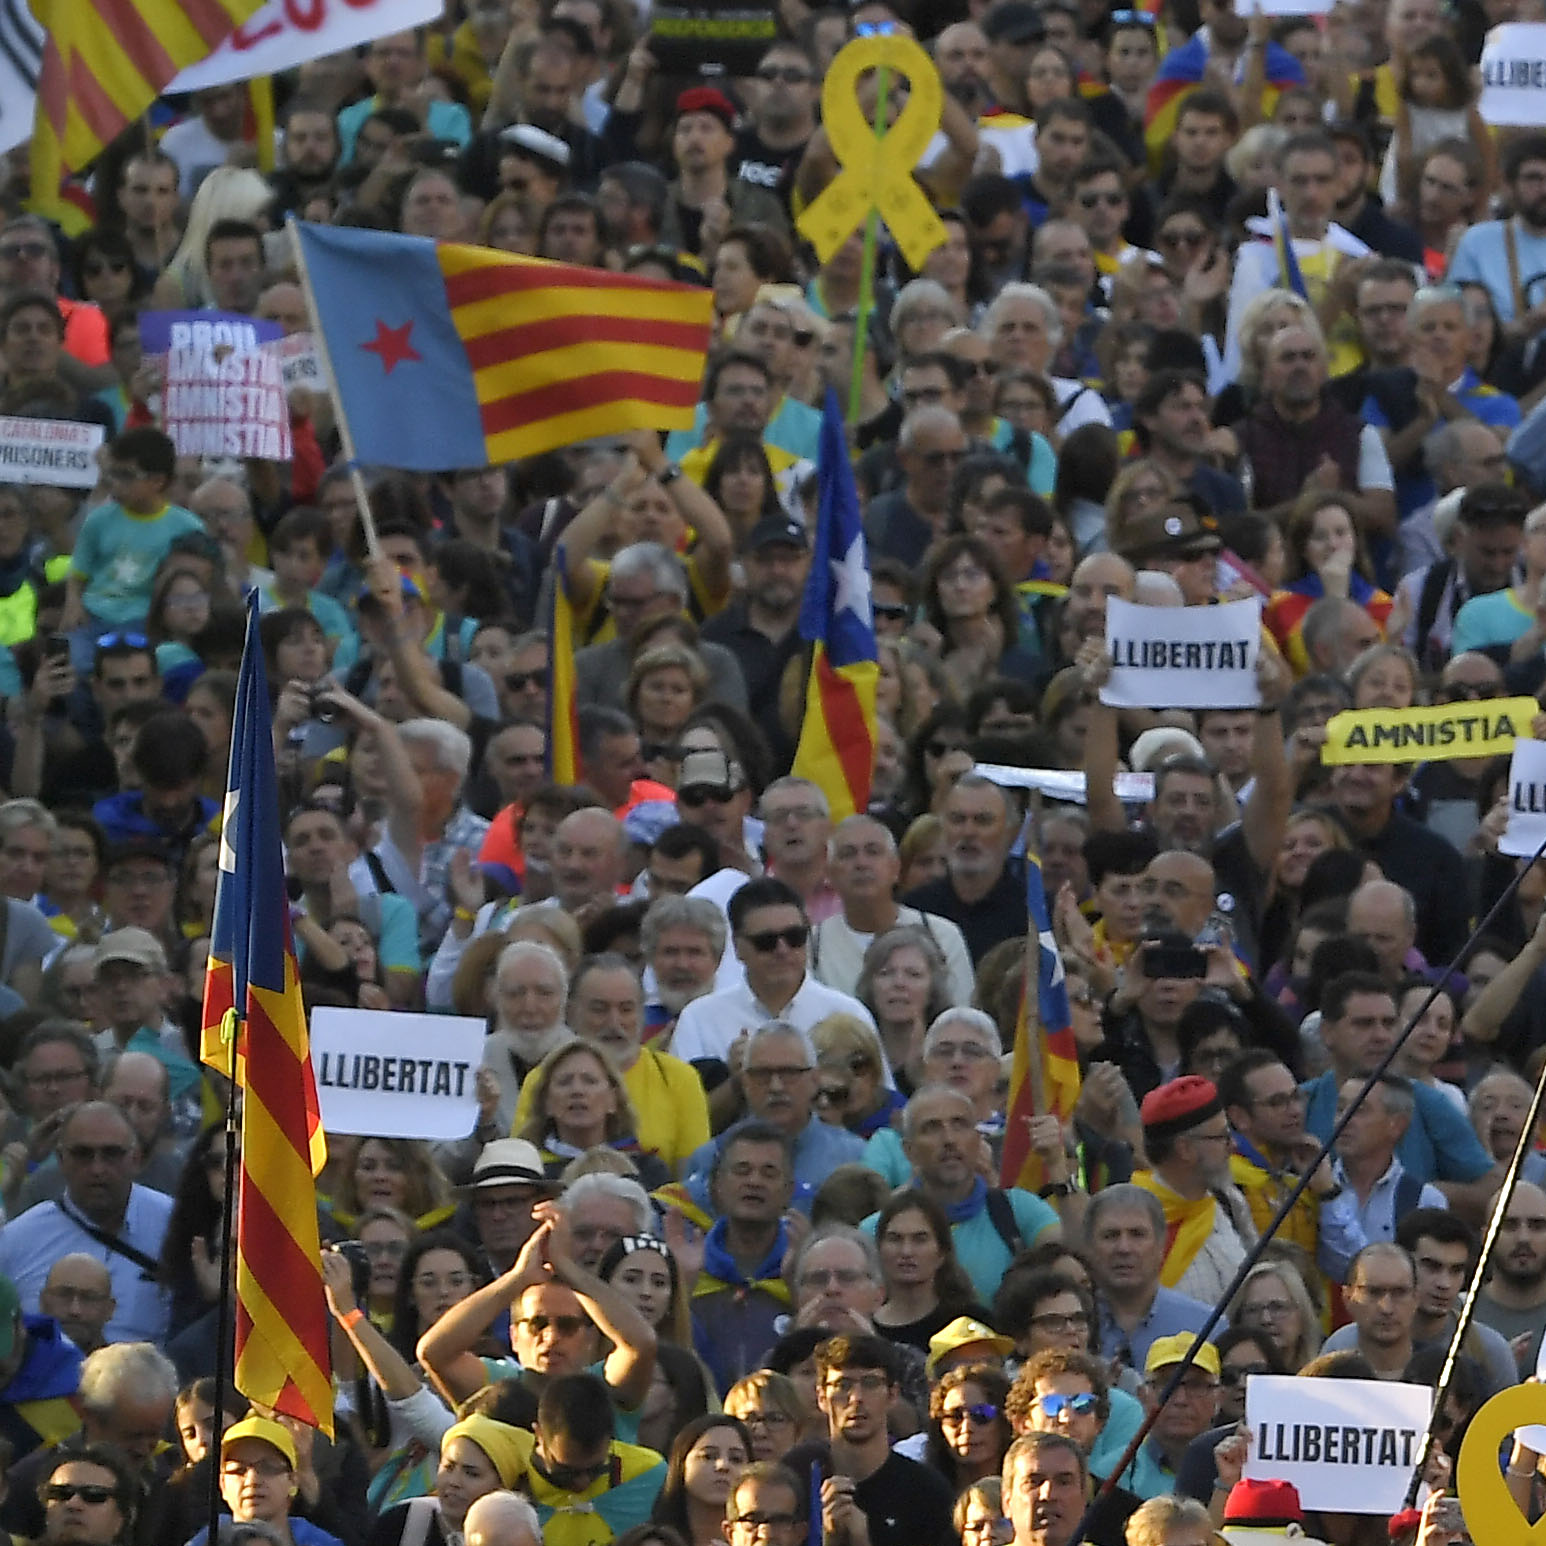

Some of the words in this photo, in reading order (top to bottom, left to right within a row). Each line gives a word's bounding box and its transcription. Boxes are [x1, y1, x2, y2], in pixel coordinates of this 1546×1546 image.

[1111, 639, 1250, 671] LLIBERTAT
[1343, 714, 1518, 751] AMNISTIA
[320, 1053, 470, 1098] LLIBERTAT
[1258, 1422, 1416, 1467] LLIBERTAT
